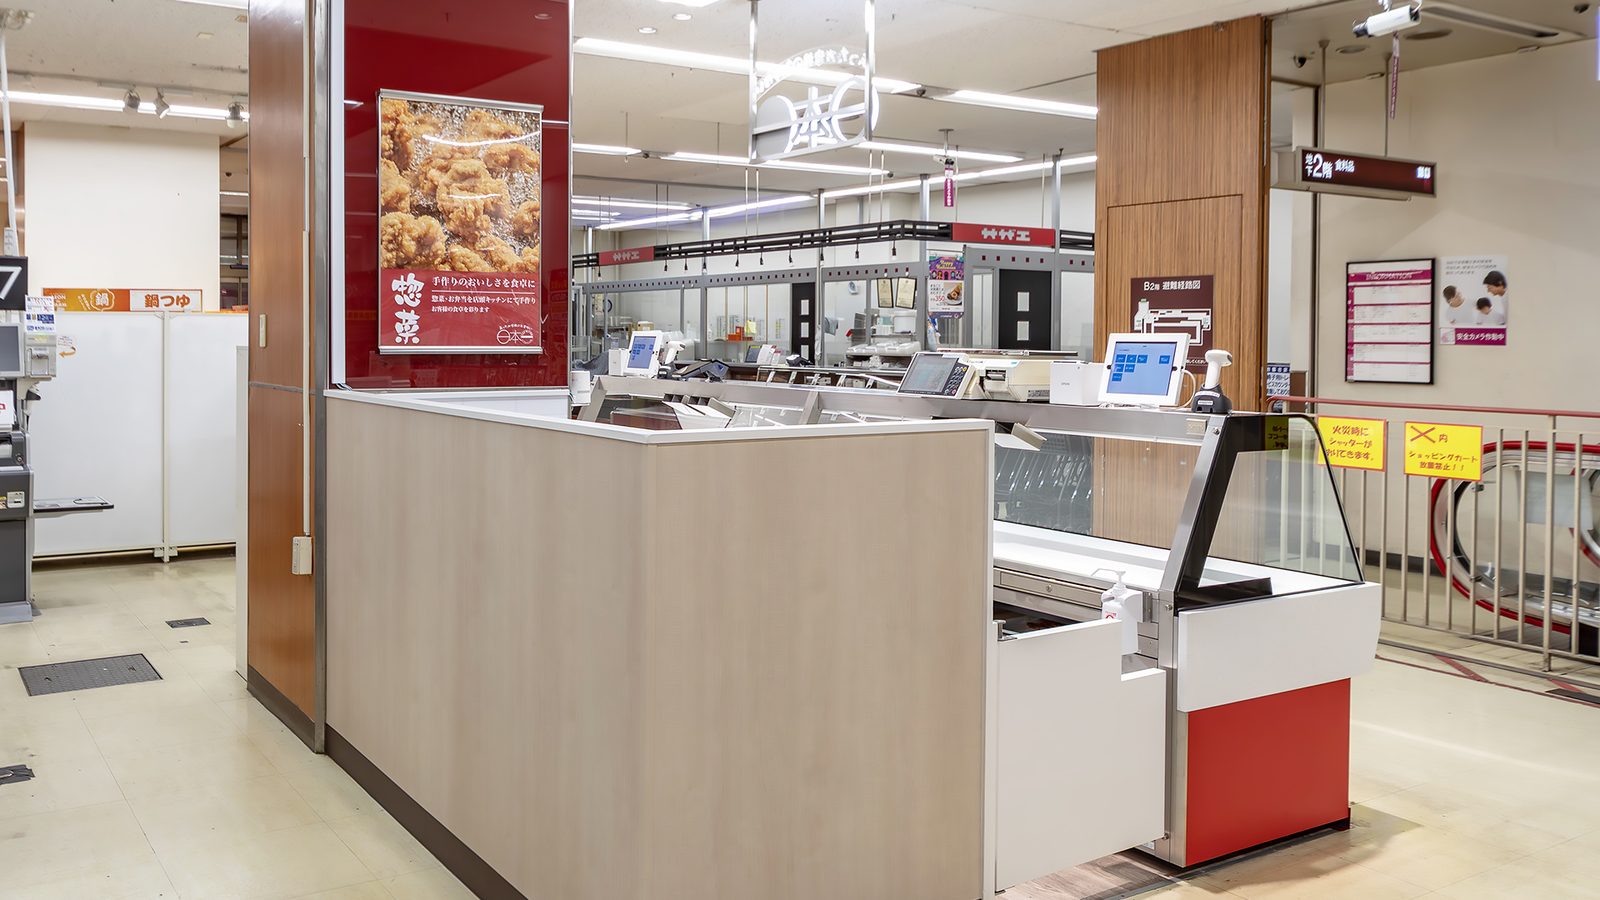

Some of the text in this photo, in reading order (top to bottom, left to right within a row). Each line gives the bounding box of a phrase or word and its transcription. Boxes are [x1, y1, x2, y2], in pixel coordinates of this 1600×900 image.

[981, 227, 1031, 242] サザエ
[0, 265, 23, 301] 7
[432, 276, 536, 289] 手作りのおいしさを食卓に
[1162, 280, 1201, 291] 避難経路図
[144, 293, 191, 308] 鍋つゆ
[391, 272, 425, 345] 惣菜
